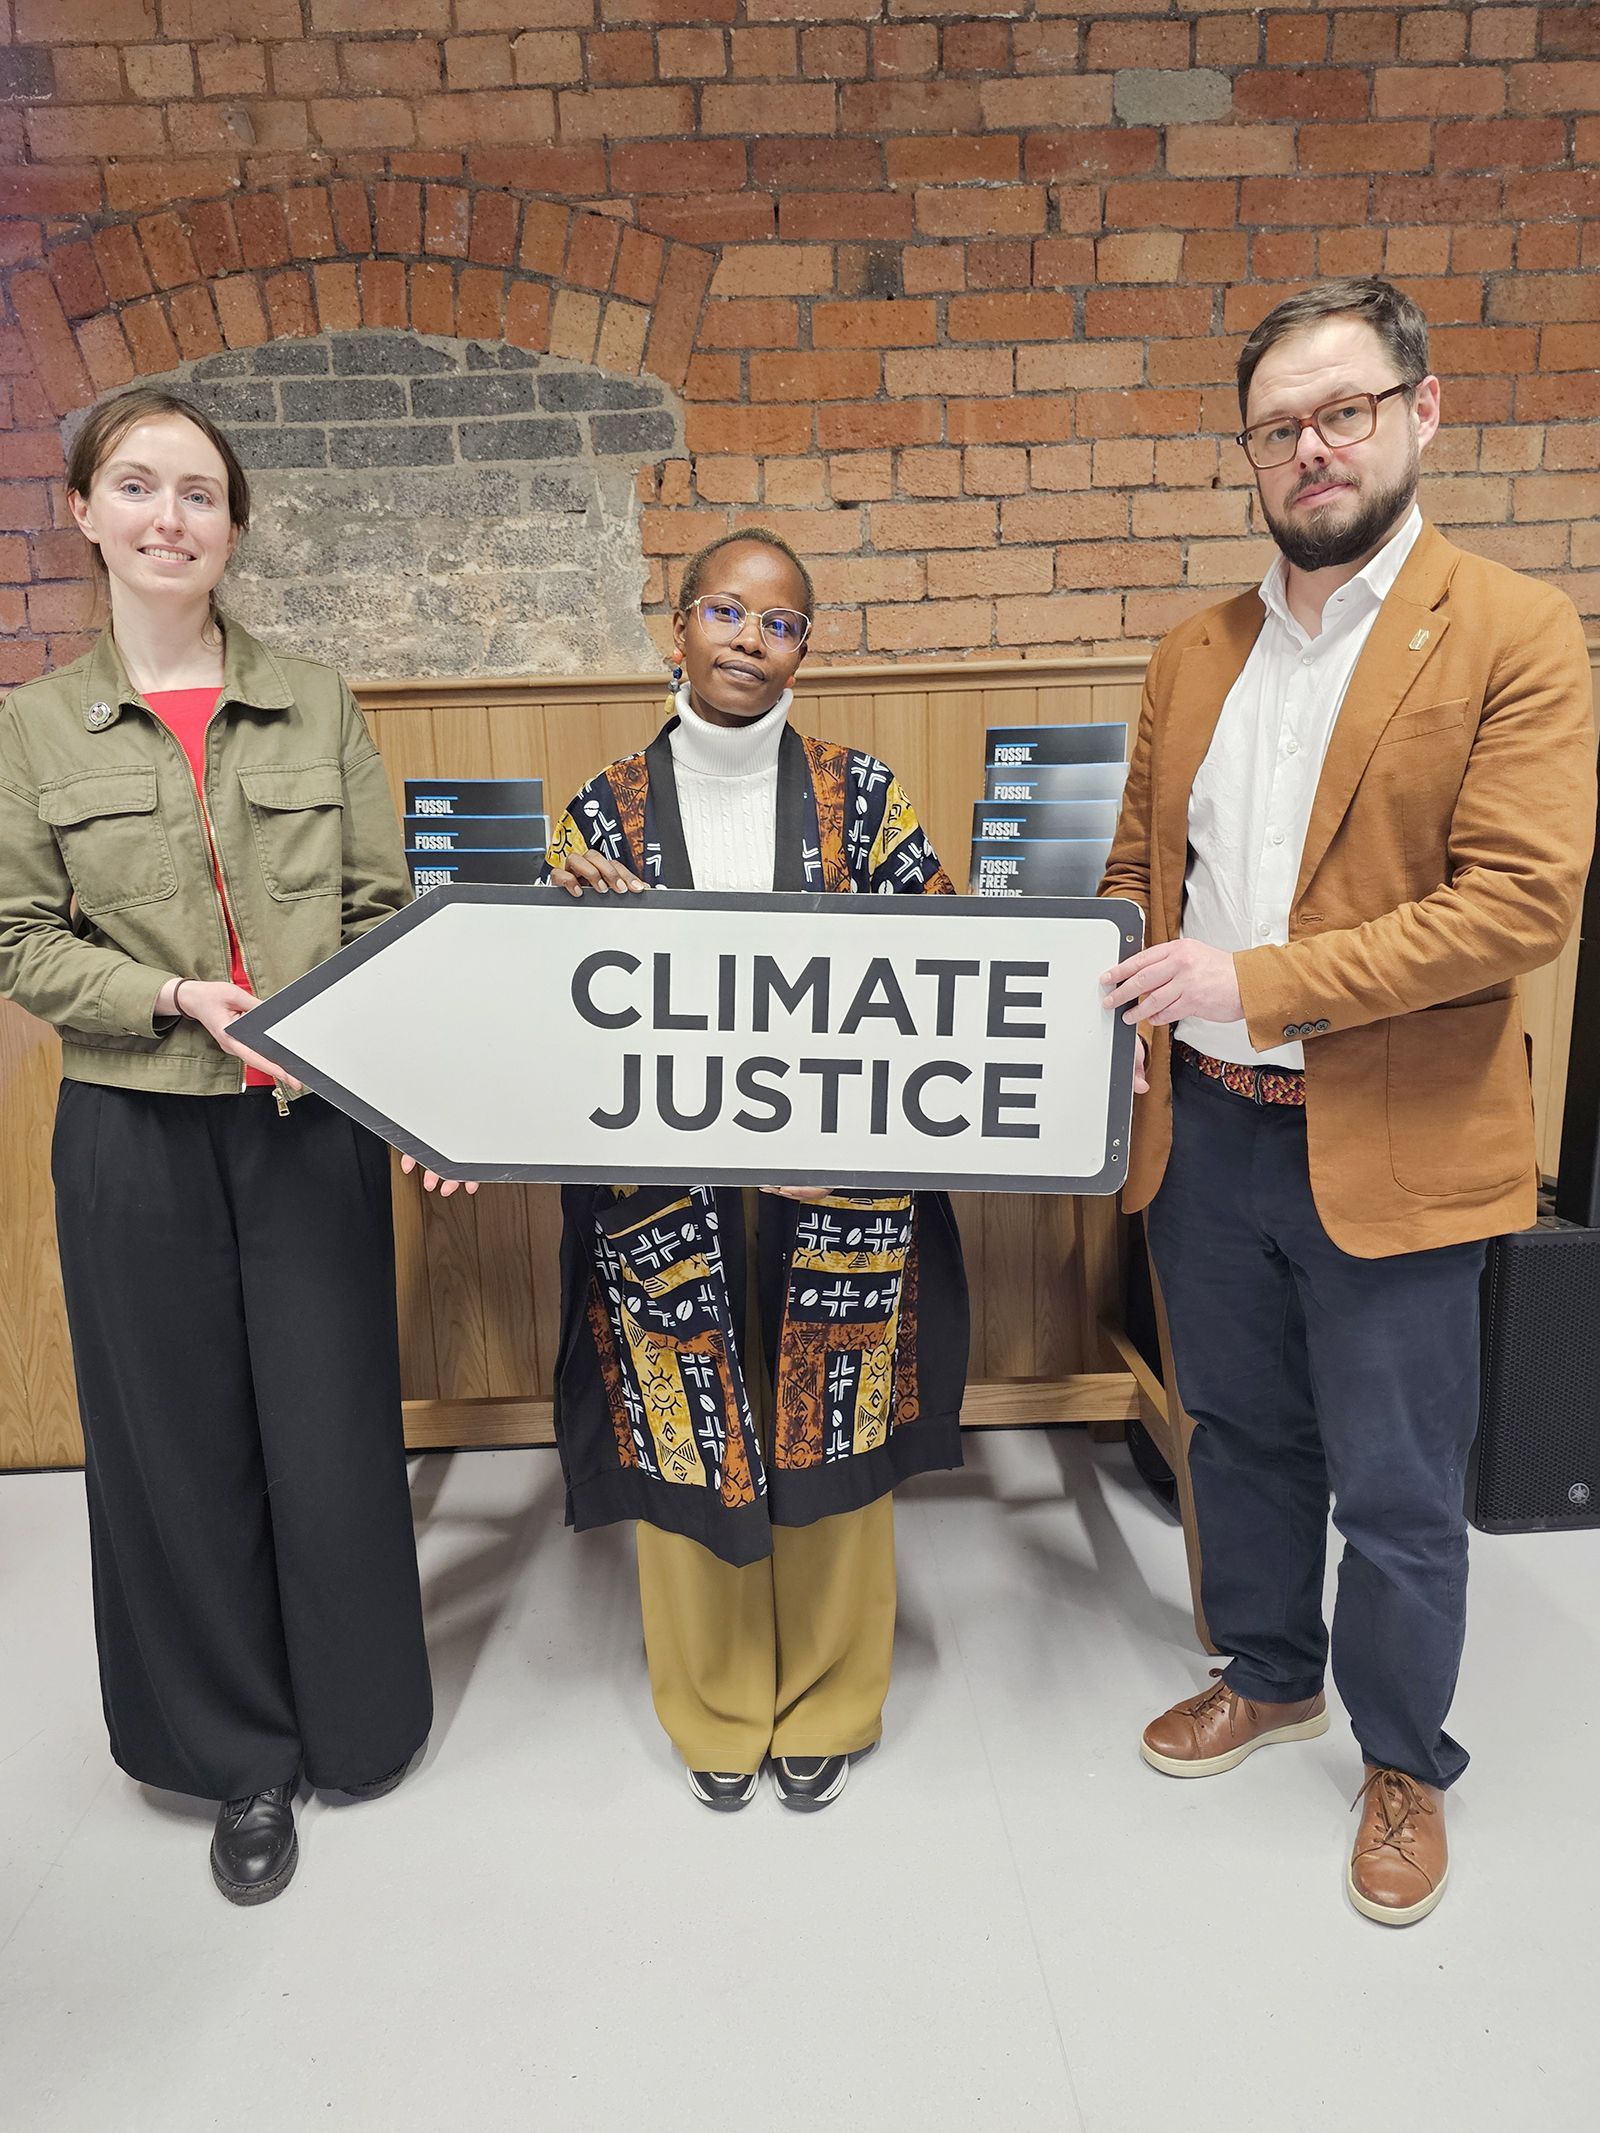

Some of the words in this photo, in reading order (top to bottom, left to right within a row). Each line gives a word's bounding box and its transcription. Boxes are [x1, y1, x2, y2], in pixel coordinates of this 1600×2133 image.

[994, 747, 1033, 762] FOSSIL
[994, 786, 1032, 800] FOSSIL
[414, 799, 454, 814] FOSSIL
[982, 822, 1021, 837] FOSSIL
[415, 836, 455, 850] FOSSIL
[980, 860, 1019, 875] FOSSIL
[414, 870, 454, 885] FOSSIL
[979, 875, 1008, 889] FREE
[570, 949, 1050, 1039] CLIMATE
[588, 1053, 1044, 1139] JUSTICE
